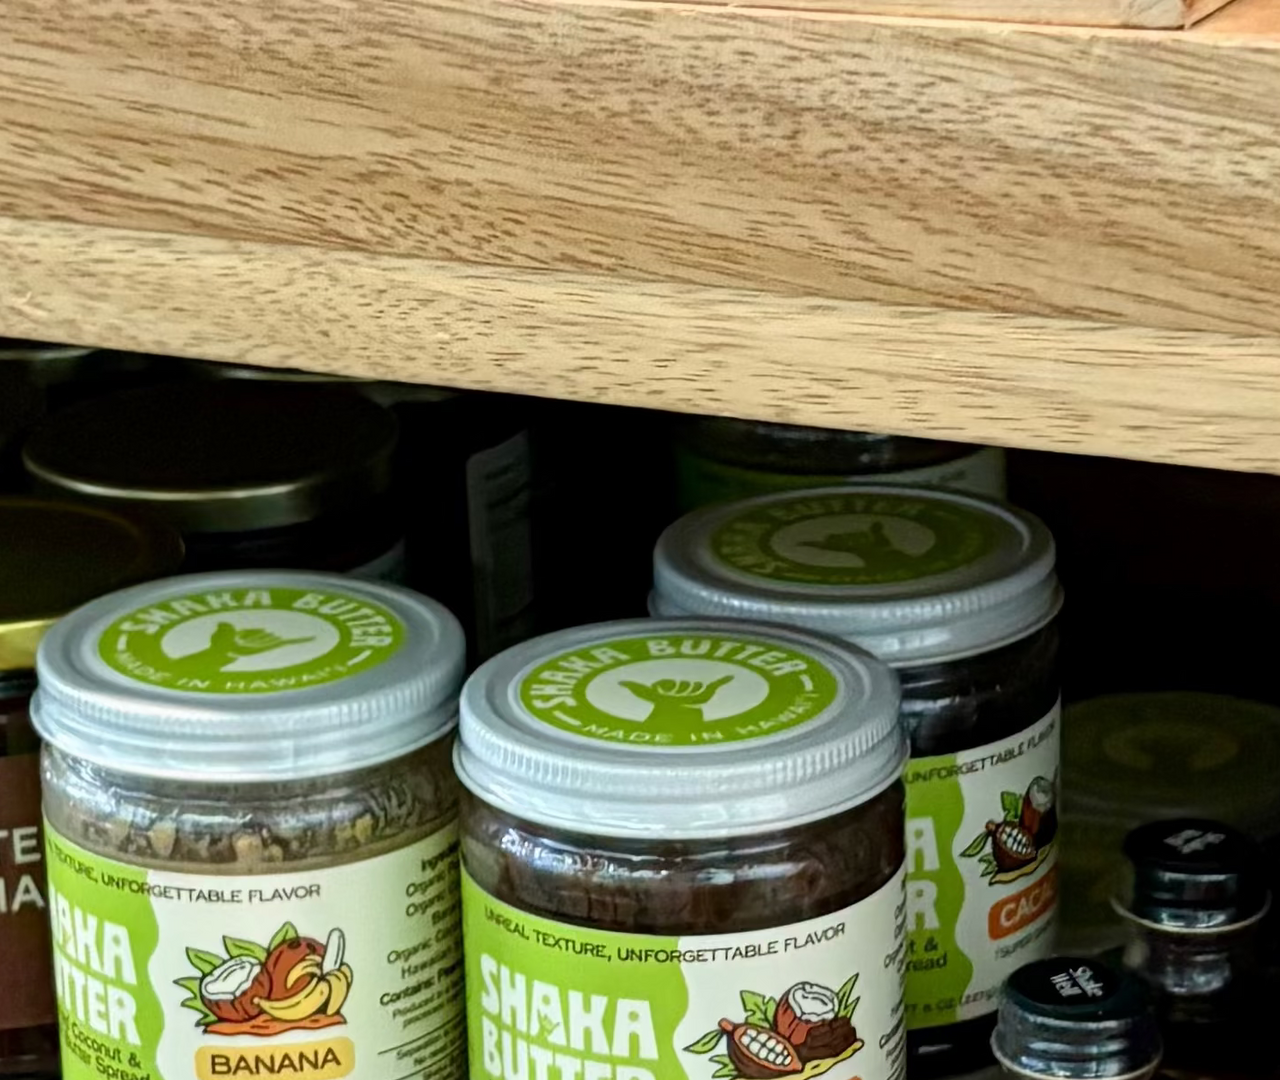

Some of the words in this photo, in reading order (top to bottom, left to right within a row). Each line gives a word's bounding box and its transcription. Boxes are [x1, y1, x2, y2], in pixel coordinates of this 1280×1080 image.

[121, 590, 272, 635] SHAKA
[293, 592, 393, 647] BUTTER
[529, 647, 631, 709] SHAKA
[647, 638, 809, 677] BUTTER
[582, 722, 671, 743] MADE
[691, 731, 725, 743] IN
[101, 871, 244, 904] UNFORGETTABLE
[248, 883, 322, 903] FLAVOR
[484, 908, 529, 940] UNREAL
[533, 928, 612, 962] TEXTURE,
[617, 940, 779, 964] UNFORGETTABLE
[784, 922, 846, 952] FLAVOR
[479, 952, 659, 1060] SHAKA
[71, 1022, 122, 1064] Coconut
[128, 1051, 142, 1070] &
[210, 1046, 343, 1076] BANANA
